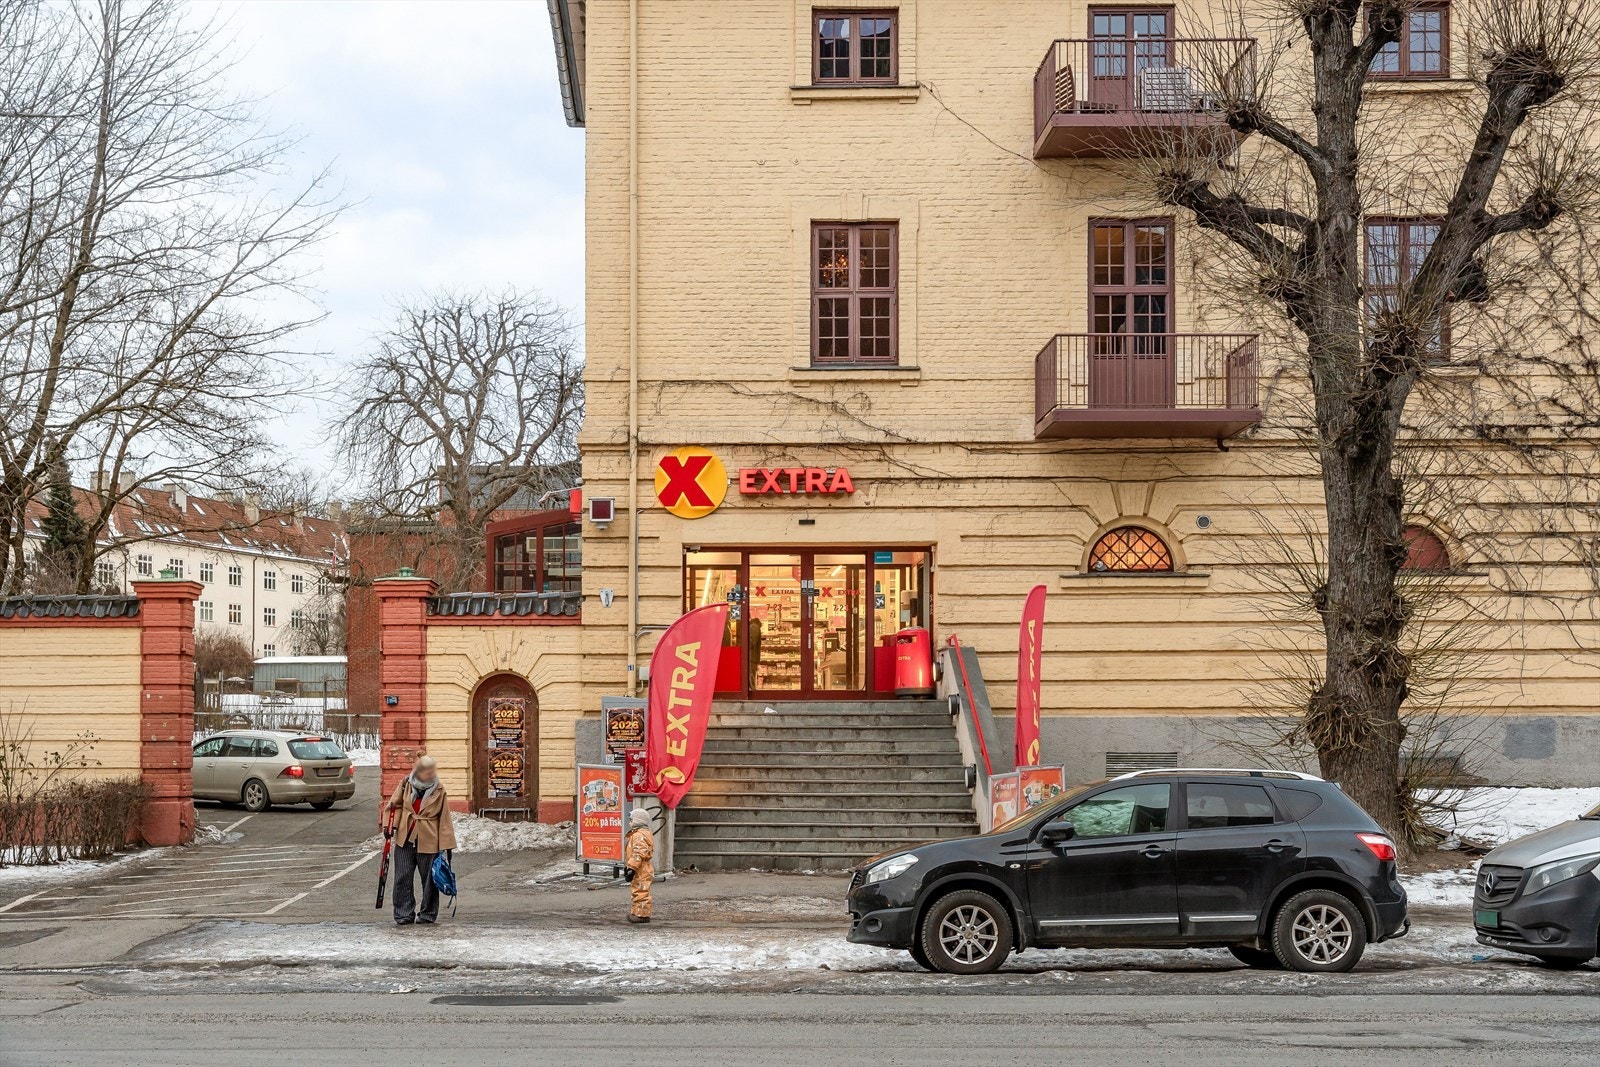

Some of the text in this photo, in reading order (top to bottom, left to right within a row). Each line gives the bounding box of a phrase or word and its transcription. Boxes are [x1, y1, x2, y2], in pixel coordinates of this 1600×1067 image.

[658, 455, 855, 507] X EXTRA
[755, 586, 766, 597] X
[822, 586, 833, 598] X
[766, 603, 783, 611] 7-23
[833, 604, 849, 612] 7-23
[665, 641, 702, 757] EXTRA
[494, 709, 520, 718] 2026
[611, 720, 639, 730] 2026
[494, 759, 519, 768] 2026
[583, 817, 622, 828] -20% på fisk
